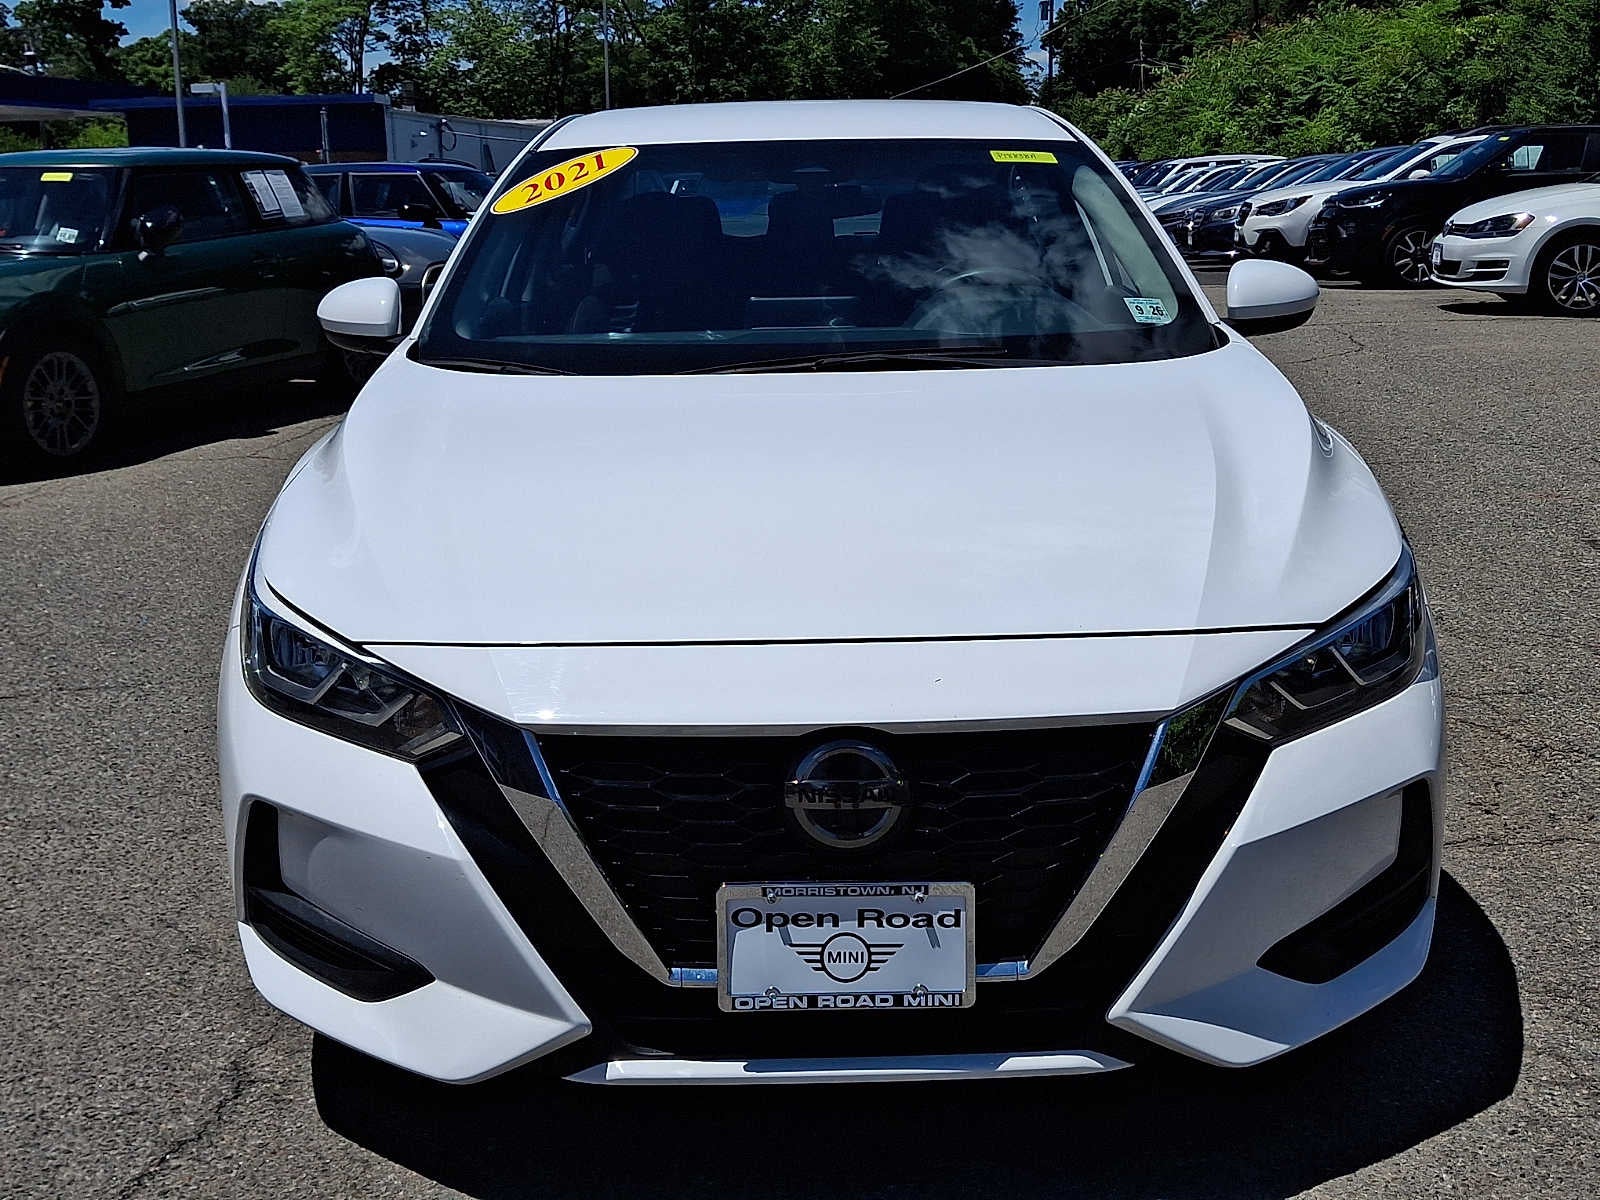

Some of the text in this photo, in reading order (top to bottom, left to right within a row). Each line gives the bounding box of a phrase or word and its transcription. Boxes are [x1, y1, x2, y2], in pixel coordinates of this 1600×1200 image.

[520, 152, 607, 204] 2021
[1134, 304, 1164, 316] 9 26
[731, 907, 962, 932] Open Road
[827, 951, 865, 964] MINI
[734, 993, 960, 1010] OPEN ROAD MINI
